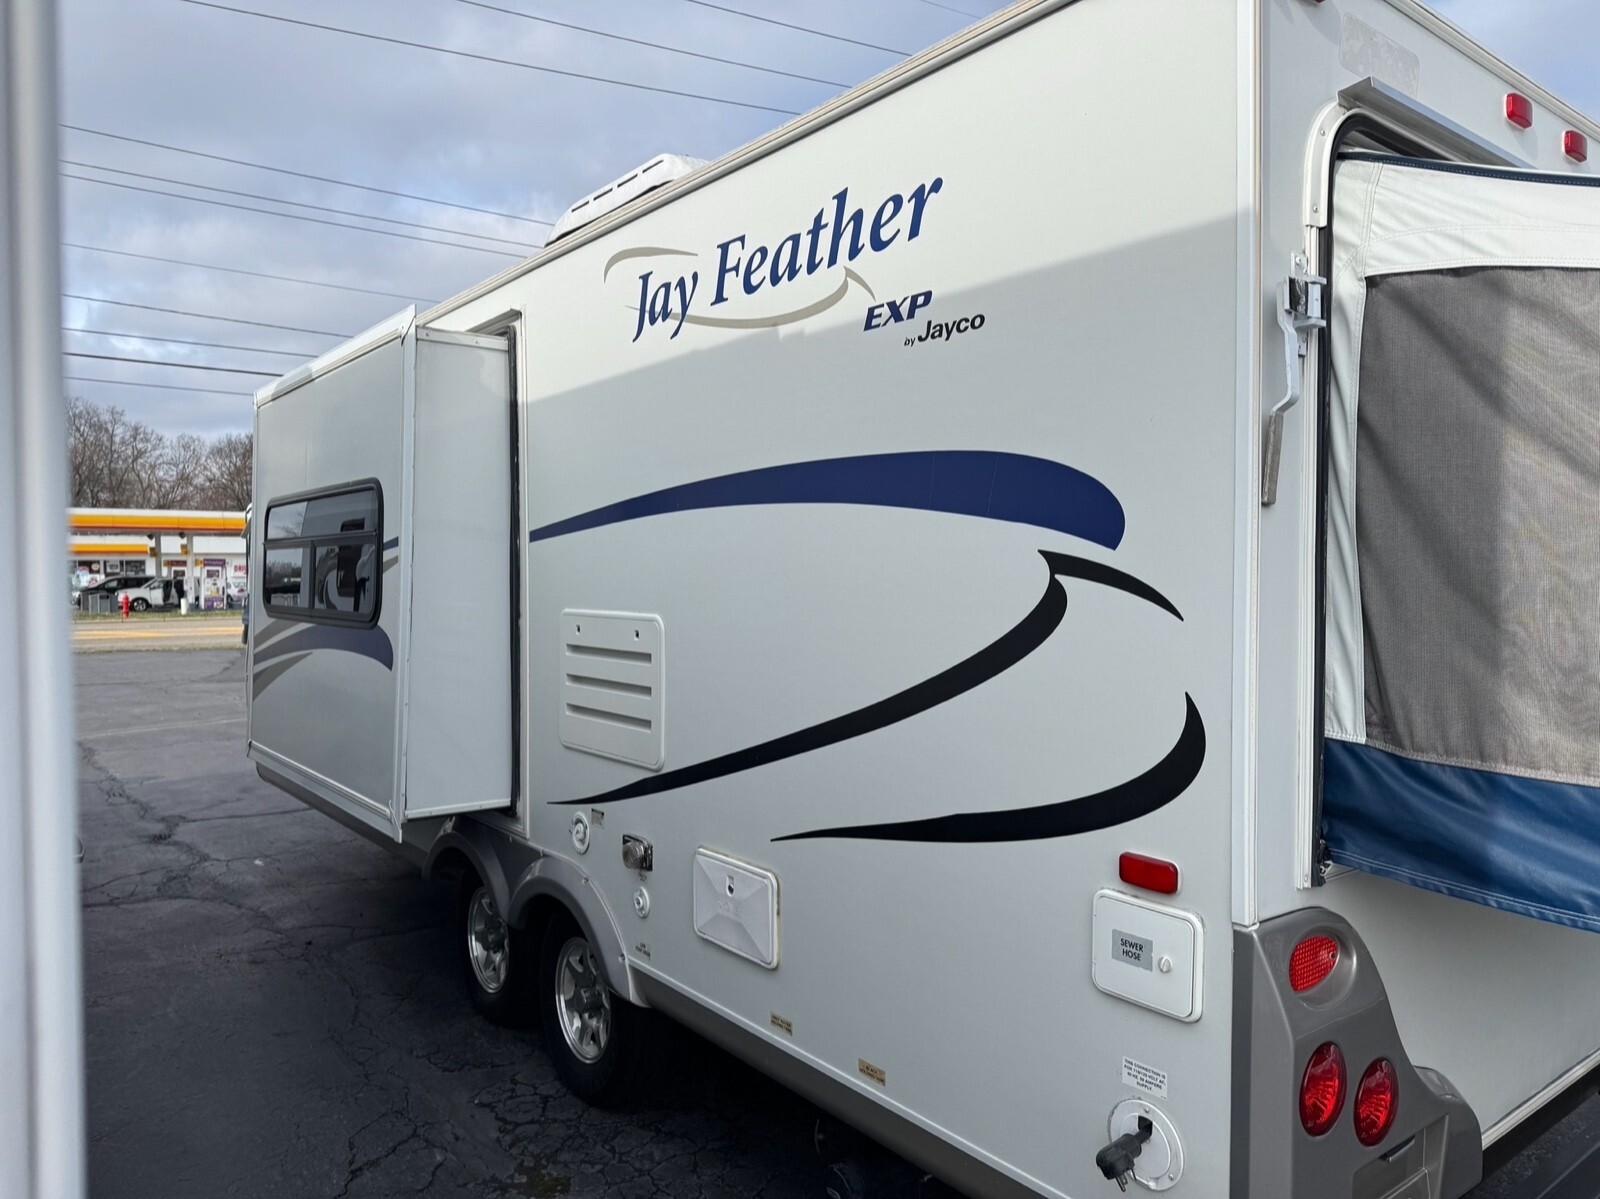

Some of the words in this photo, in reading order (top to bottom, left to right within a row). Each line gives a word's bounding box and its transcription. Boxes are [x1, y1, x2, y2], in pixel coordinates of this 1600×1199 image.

[632, 270, 698, 342] Jay
[711, 177, 943, 306] Feather
[863, 290, 933, 332] EXP
[904, 336, 916, 347] by
[918, 313, 985, 343] Jayco
[1120, 938, 1143, 952] SEWER
[1122, 948, 1141, 961] HOSE
